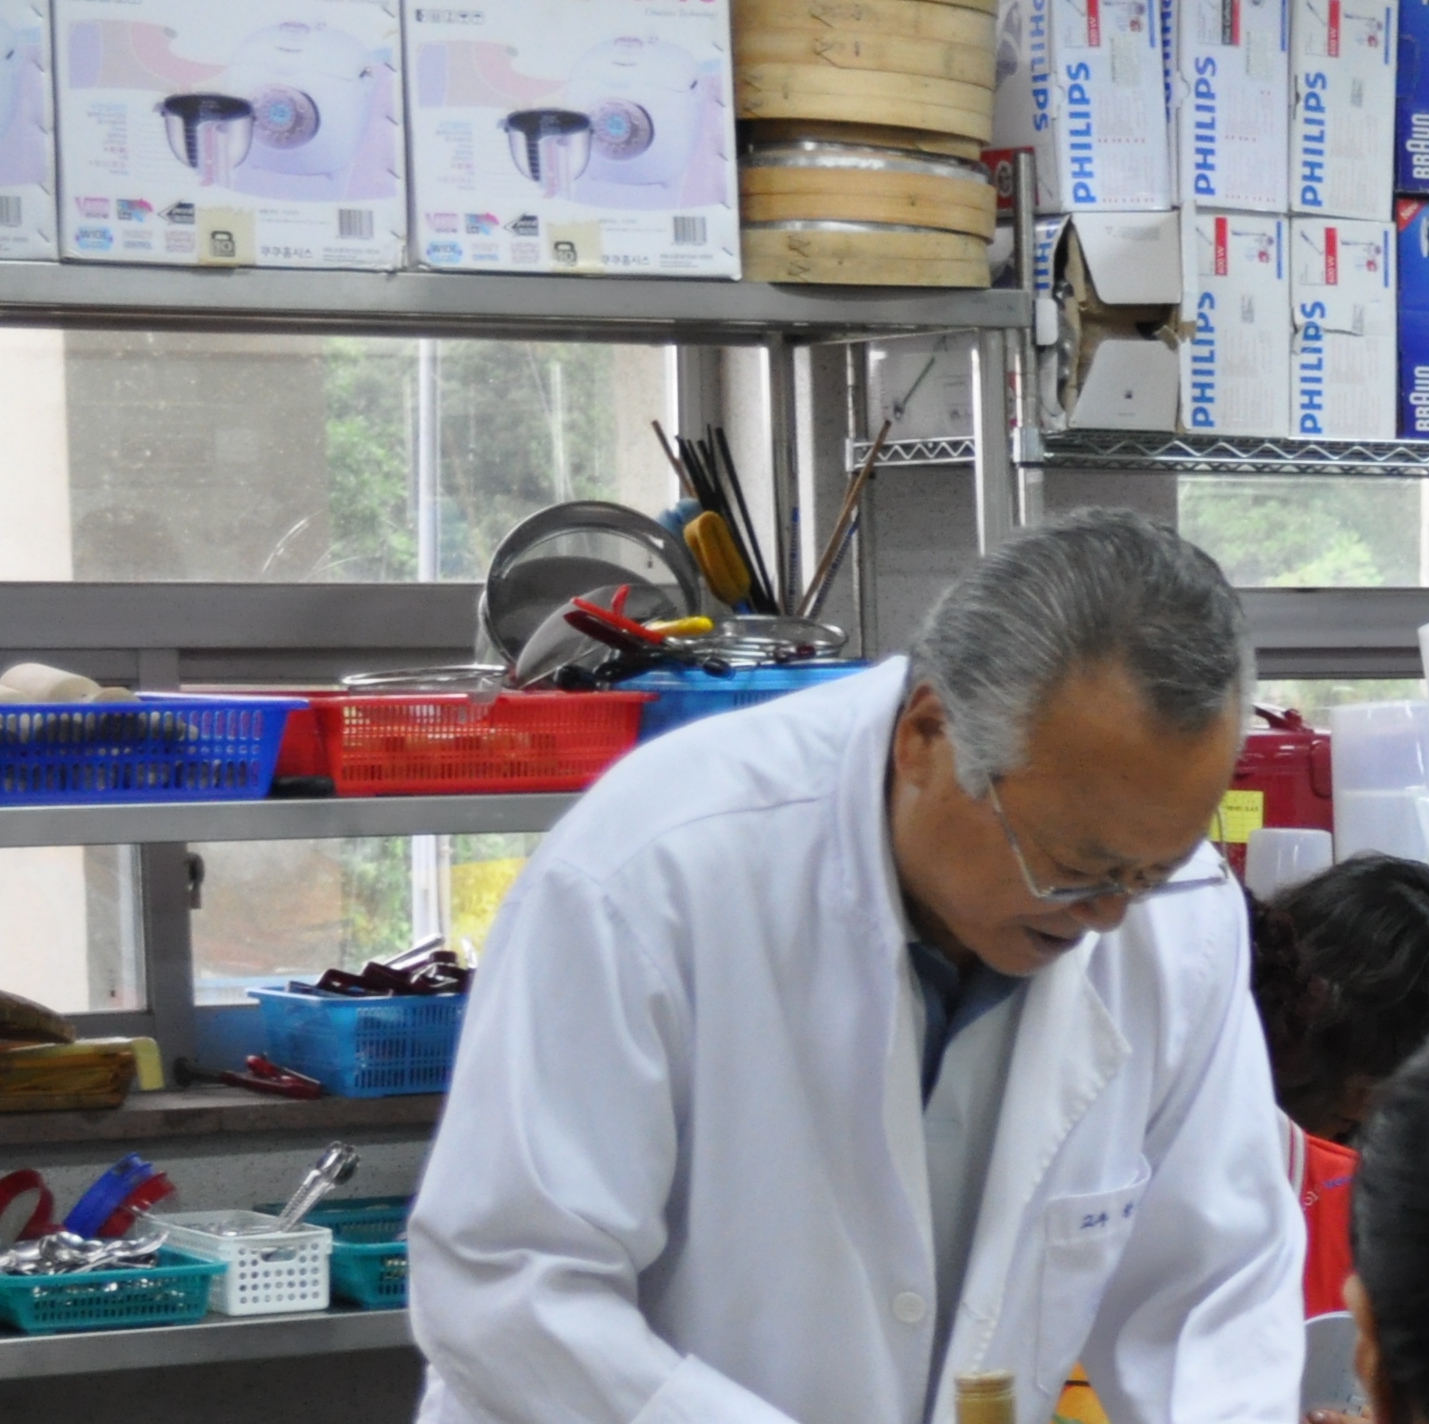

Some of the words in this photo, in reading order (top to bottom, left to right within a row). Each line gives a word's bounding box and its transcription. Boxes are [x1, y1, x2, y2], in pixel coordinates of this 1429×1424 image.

[1066, 62, 1096, 203] PHILIPS
[1194, 56, 1217, 196] PHILIPS
[1301, 72, 1327, 207] PHILIPS
[1191, 291, 1215, 428] PHILIPS
[1300, 301, 1326, 434] PHILIPS
